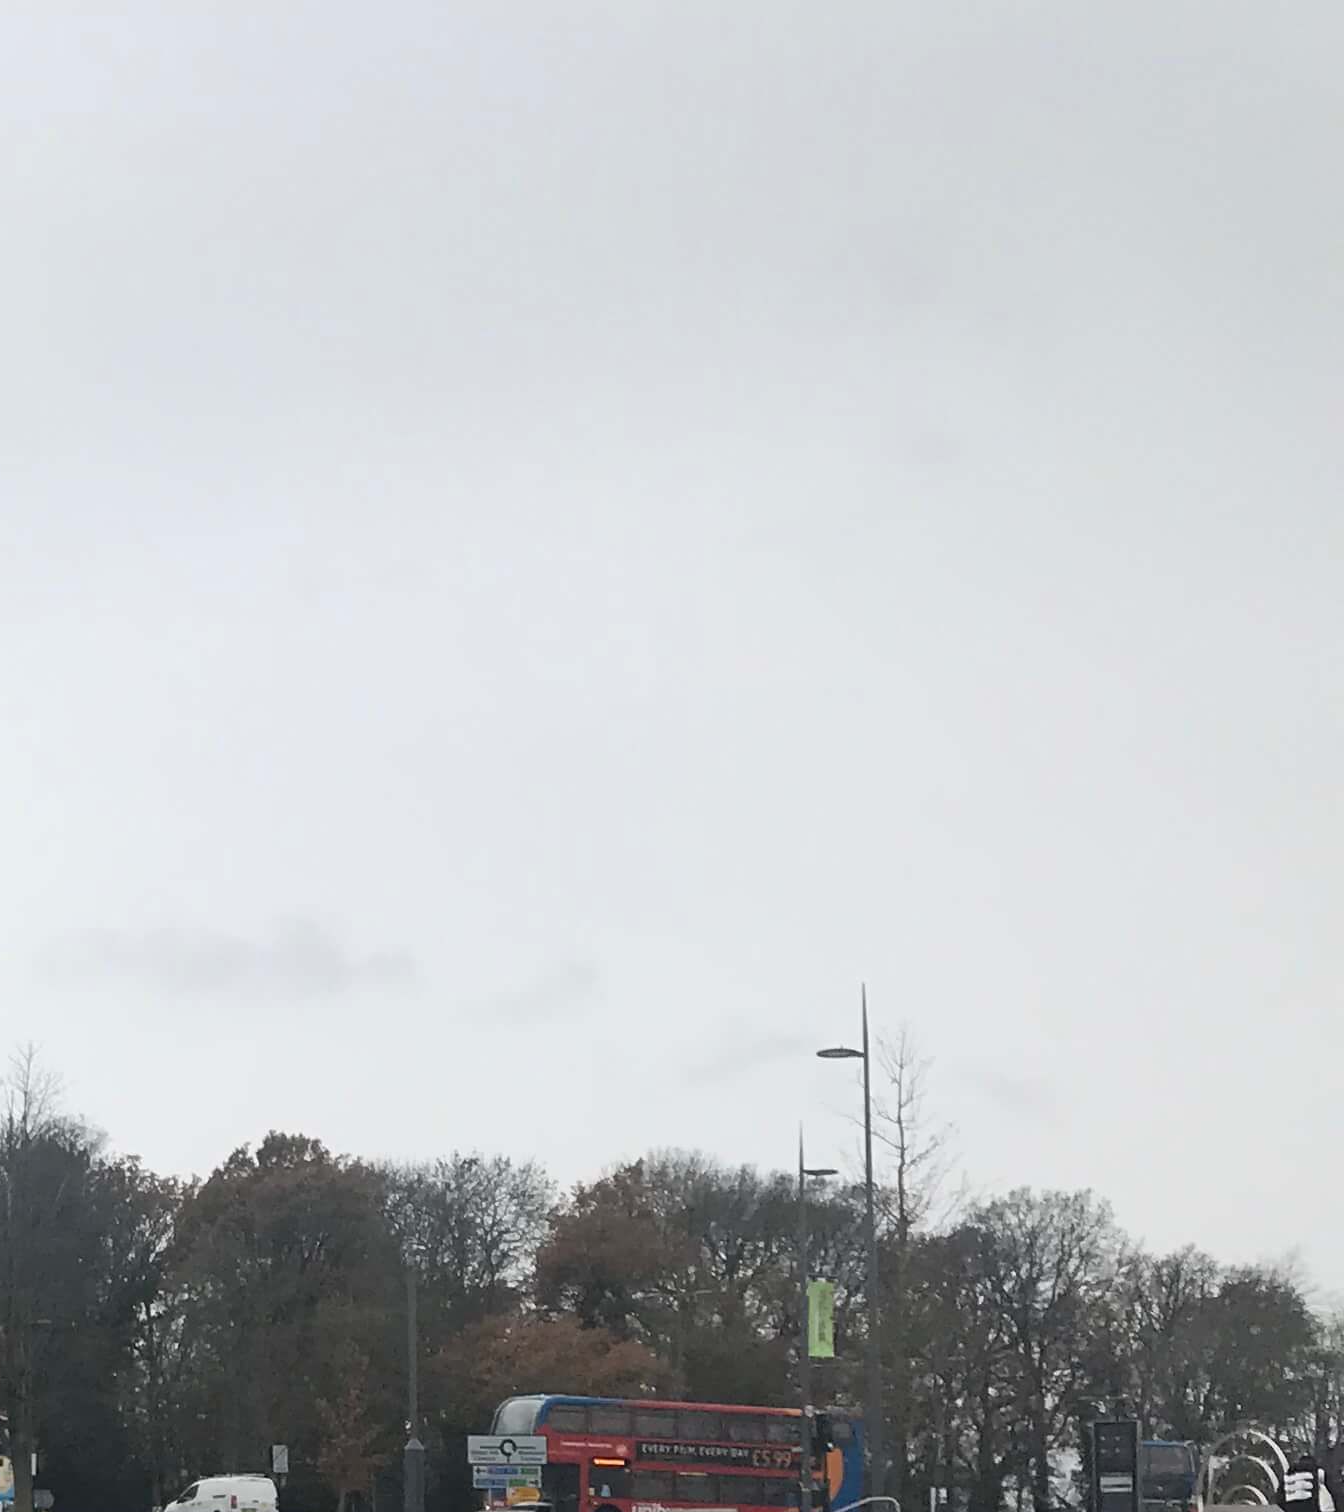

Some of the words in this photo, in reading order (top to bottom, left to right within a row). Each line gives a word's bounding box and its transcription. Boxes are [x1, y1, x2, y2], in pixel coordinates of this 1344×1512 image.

[641, 1443, 671, 1454] EVERY
[699, 1446, 729, 1456] EVERY
[729, 1447, 750, 1458] DAY
